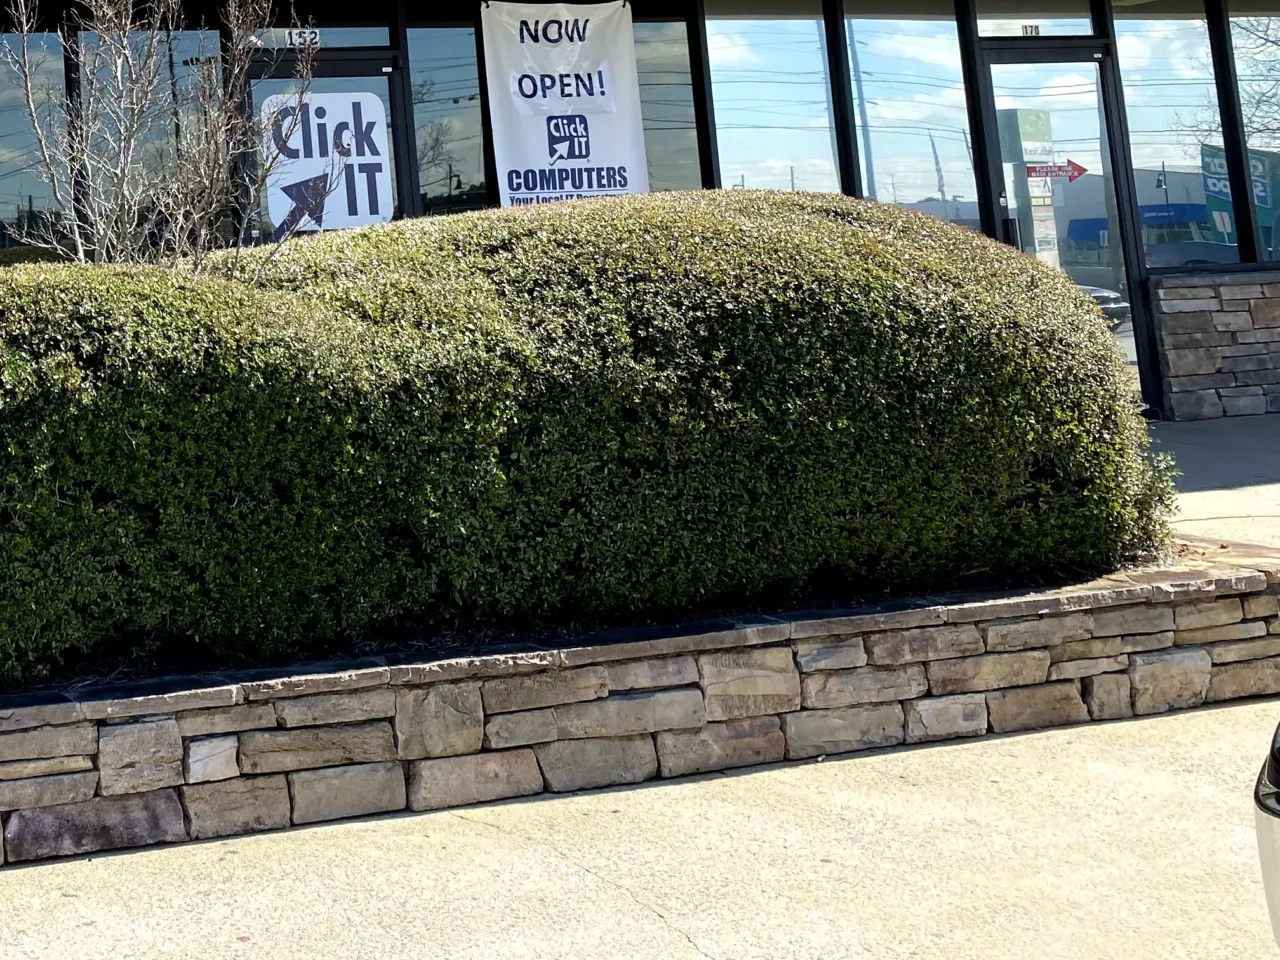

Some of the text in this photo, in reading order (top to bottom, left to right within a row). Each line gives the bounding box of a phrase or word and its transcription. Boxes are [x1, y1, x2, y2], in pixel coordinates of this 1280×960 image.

[287, 30, 319, 47] 152
[519, 18, 590, 44] NOW
[1024, 25, 1040, 36] 170
[517, 70, 606, 99] OPEN!
[272, 101, 382, 160] Click
[549, 117, 587, 137] Click
[574, 137, 588, 156] IT
[344, 162, 383, 216] IT
[507, 165, 628, 192] COMPUTERS
